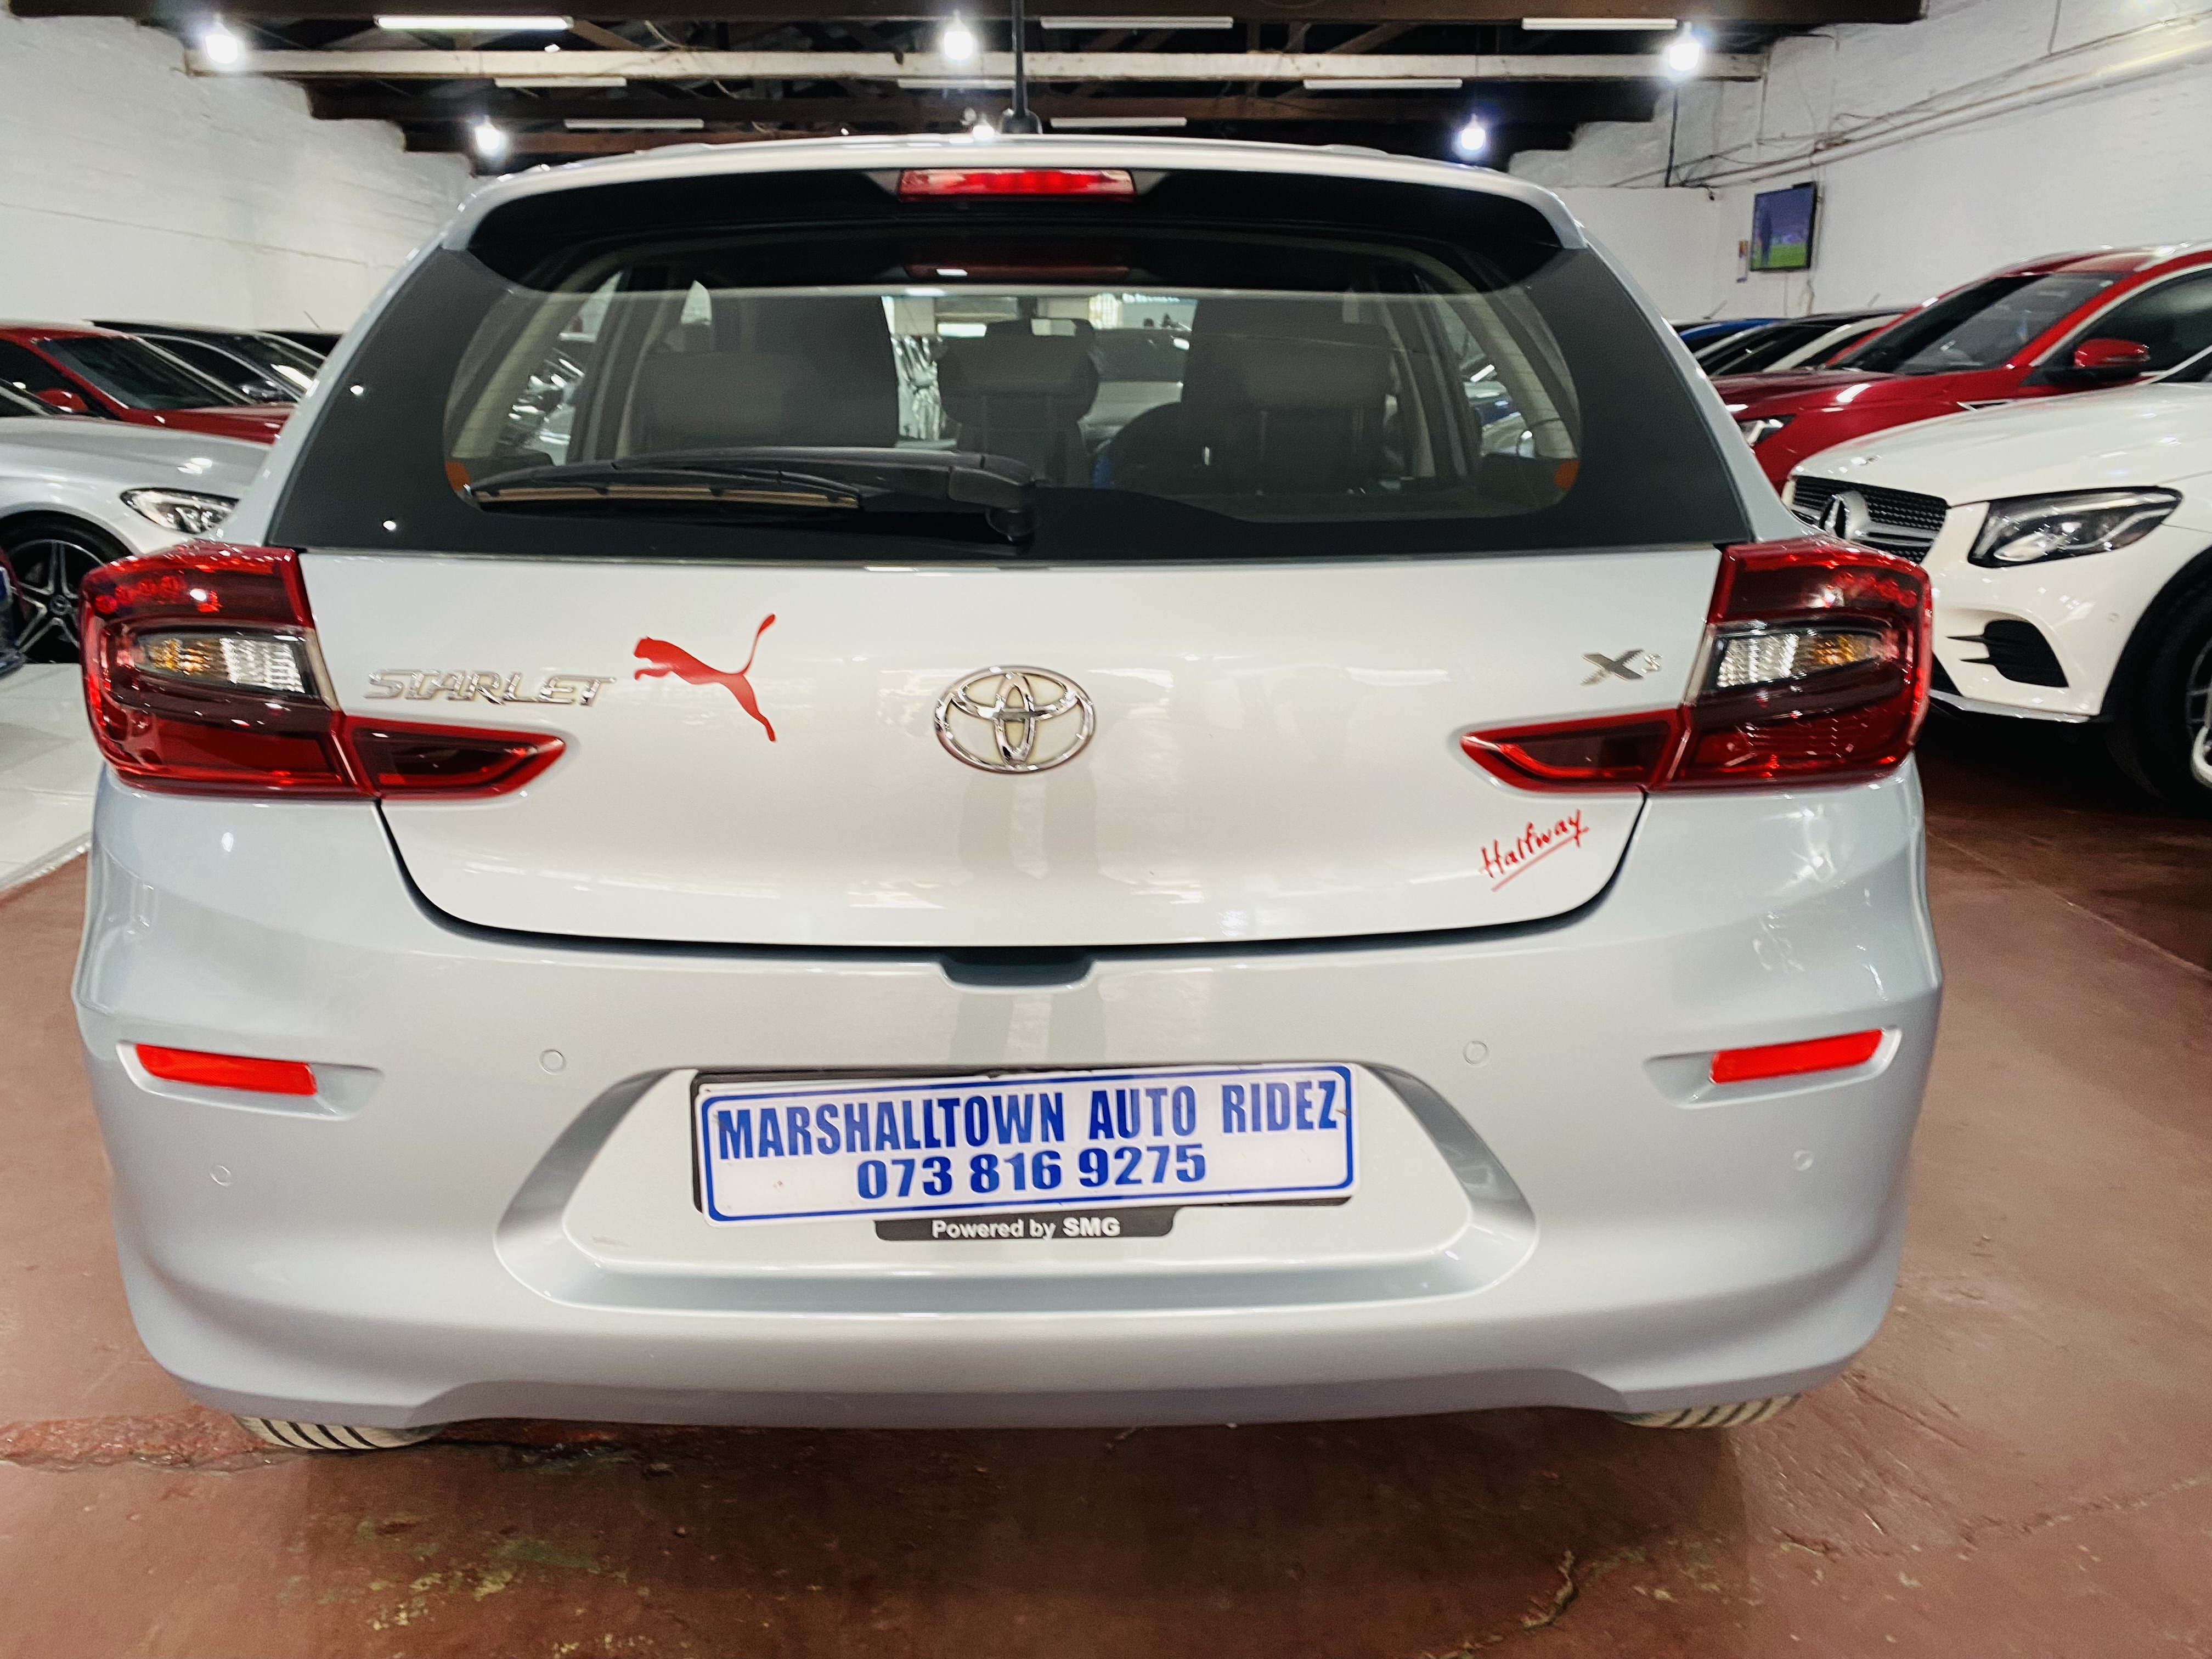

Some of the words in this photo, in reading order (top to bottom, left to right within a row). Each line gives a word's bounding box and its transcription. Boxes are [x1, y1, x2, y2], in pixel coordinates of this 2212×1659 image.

[363, 668, 617, 707] STARLET
[1480, 808, 1585, 879] Halfway
[716, 1092, 1065, 1160] MARSHALLTOWN
[1088, 1085, 1197, 1141] AUTO
[1221, 1079, 1339, 1134] RIDEZ
[857, 1155, 953, 1199] 073
[969, 1150, 1062, 1194] 816
[1078, 1143, 1206, 1188] 9275
[932, 1218, 1024, 1239] Powered
[1029, 1218, 1056, 1240] by
[1062, 1216, 1121, 1238] SMG
